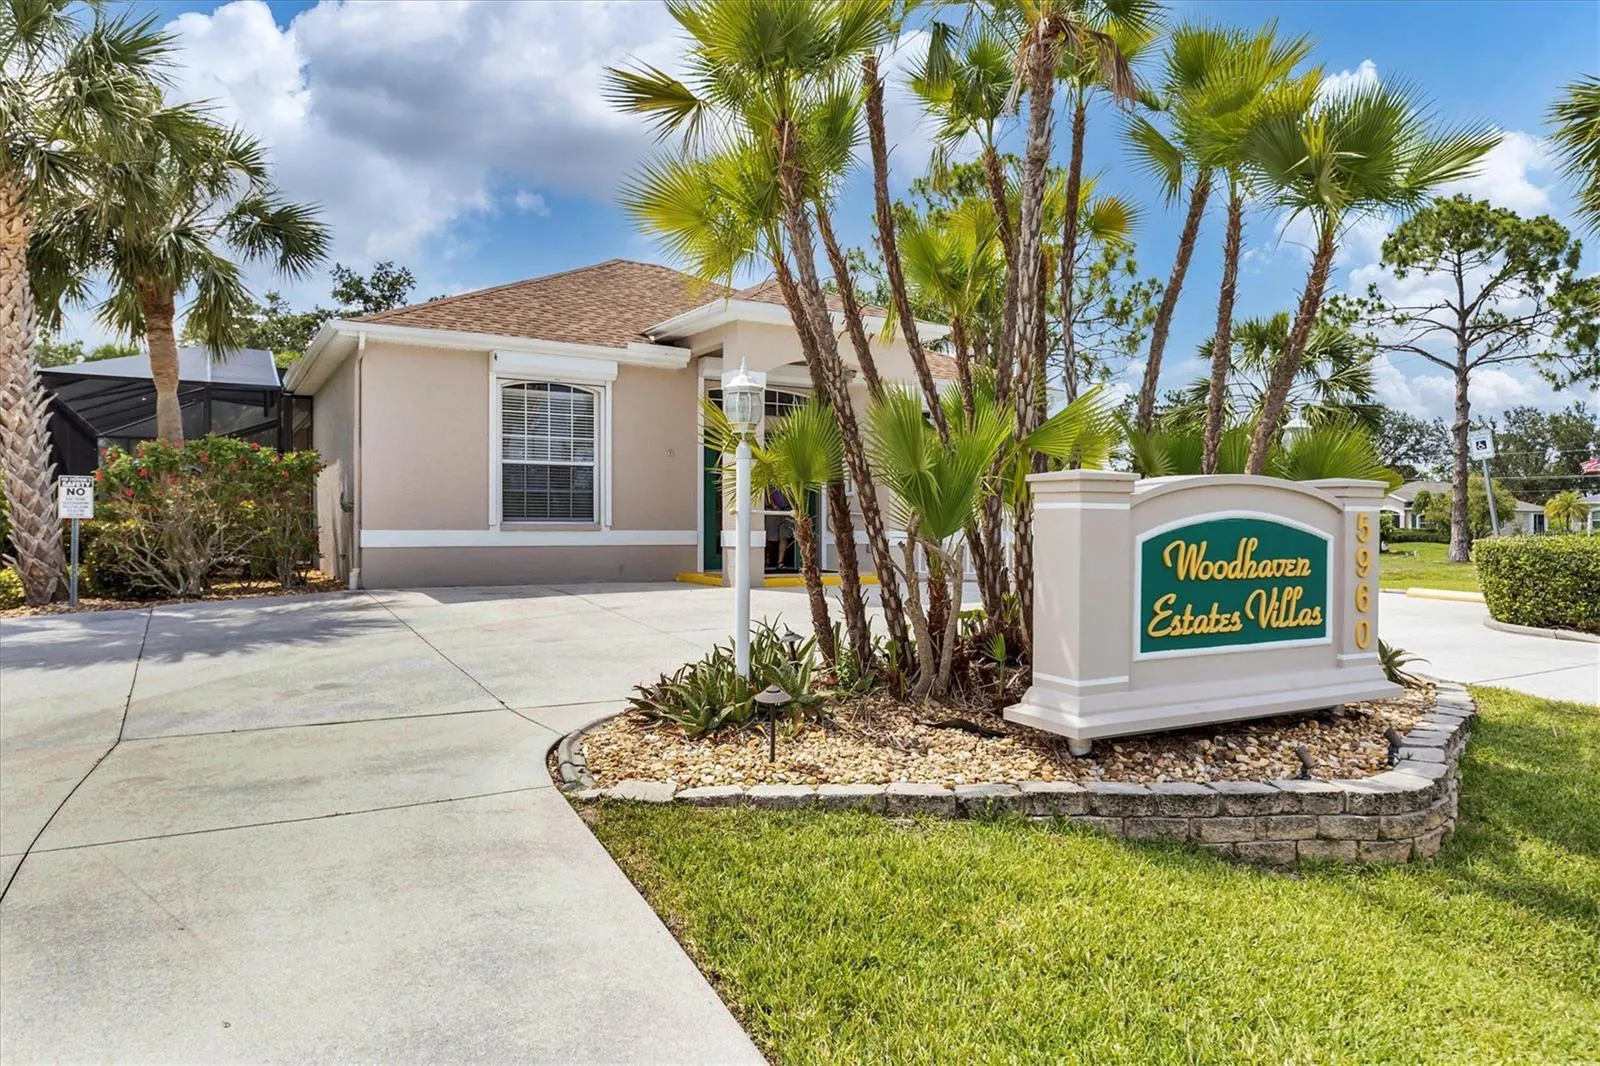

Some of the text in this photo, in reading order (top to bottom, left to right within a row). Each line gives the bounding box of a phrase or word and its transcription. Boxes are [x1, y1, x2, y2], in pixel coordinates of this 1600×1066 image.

[66, 488, 85, 496] NO
[1163, 537, 1311, 581] Woodhaven
[1356, 512, 1372, 650] 5960
[1147, 586, 1323, 638] Estates Villas
